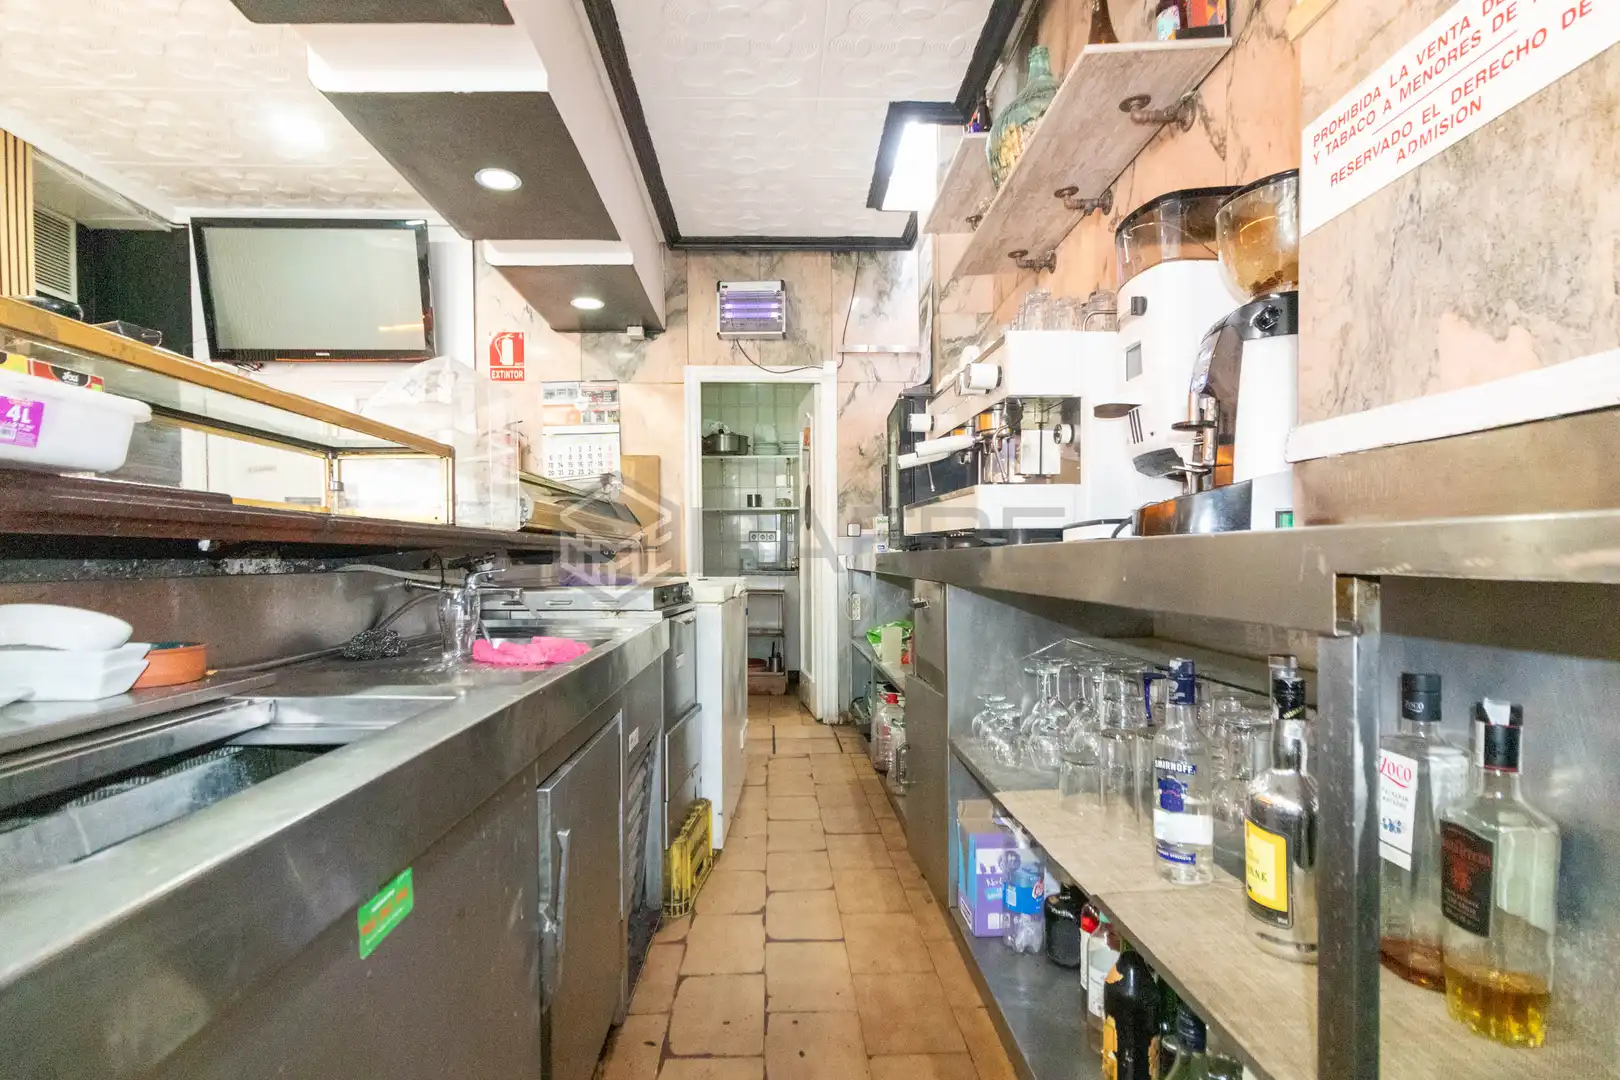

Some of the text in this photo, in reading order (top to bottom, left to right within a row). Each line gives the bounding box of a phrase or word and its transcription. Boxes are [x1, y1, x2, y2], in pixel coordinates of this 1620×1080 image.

[1313, 86, 1381, 147] PROHIBIDA
[1390, 64, 1408, 89] LA
[1416, 15, 1471, 66] VENTA
[1313, 1, 1518, 165] Y TABACO A MENORES DE
[1330, 0, 1593, 187] RESERVADO EL DERECHO DE
[1396, 95, 1482, 164] ADMISION
[5, 405, 32, 424] 4L
[491, 370, 524, 380] EXTINTOR
